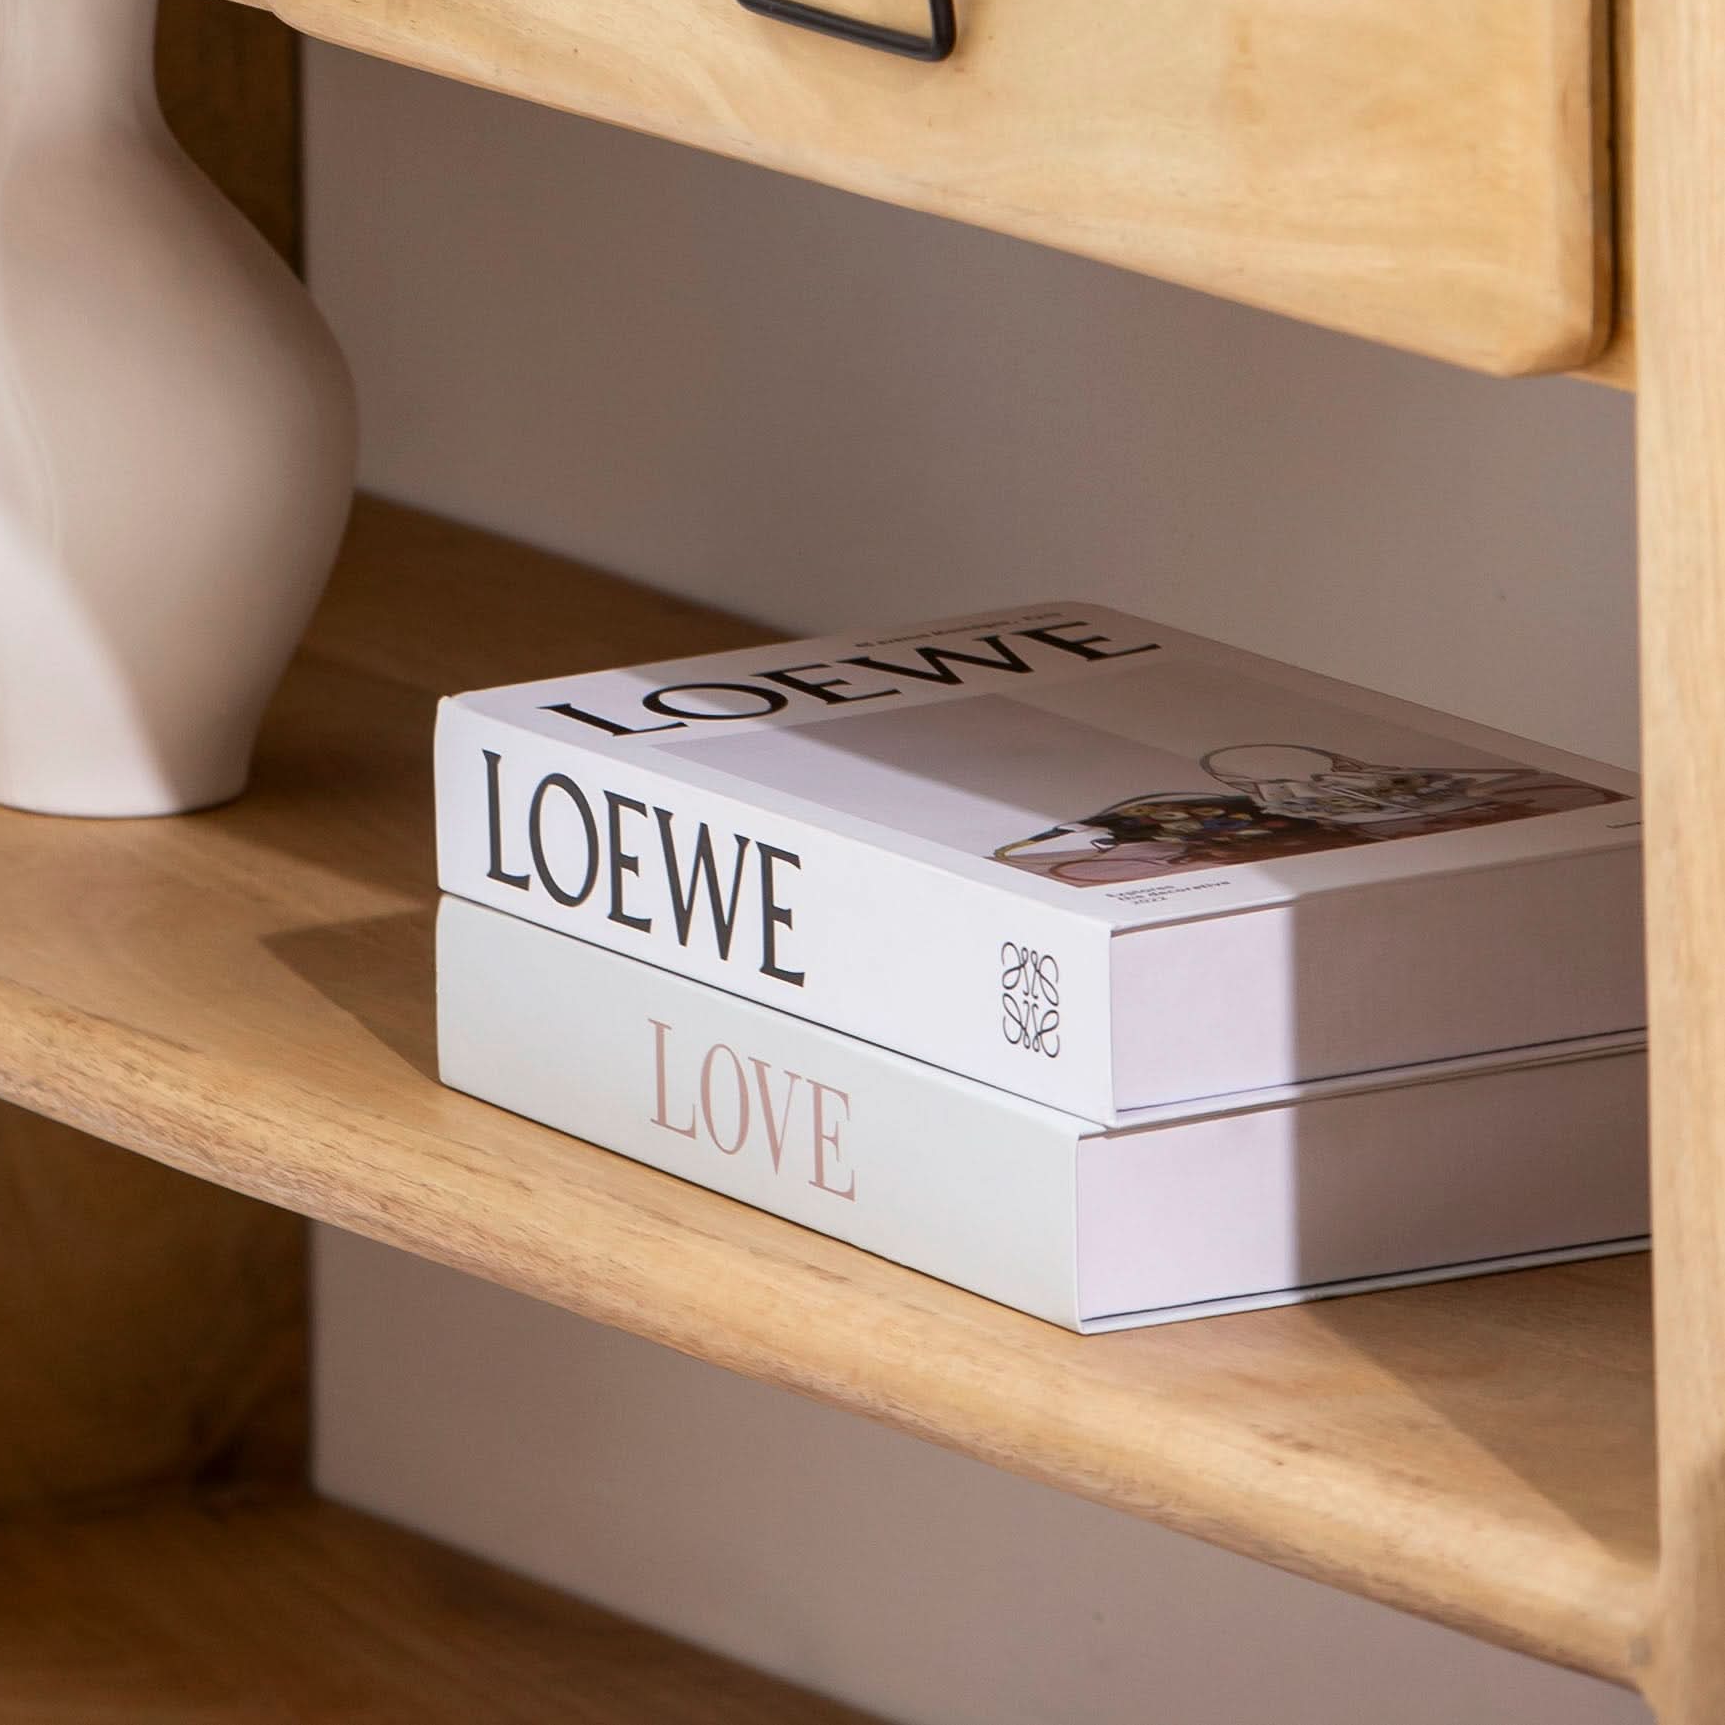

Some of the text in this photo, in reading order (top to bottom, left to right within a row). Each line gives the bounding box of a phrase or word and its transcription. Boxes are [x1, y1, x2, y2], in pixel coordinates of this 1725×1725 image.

[538, 621, 1161, 737] LOEWE
[482, 748, 806, 988] LOEWE
[647, 1017, 856, 1202] LOVE
